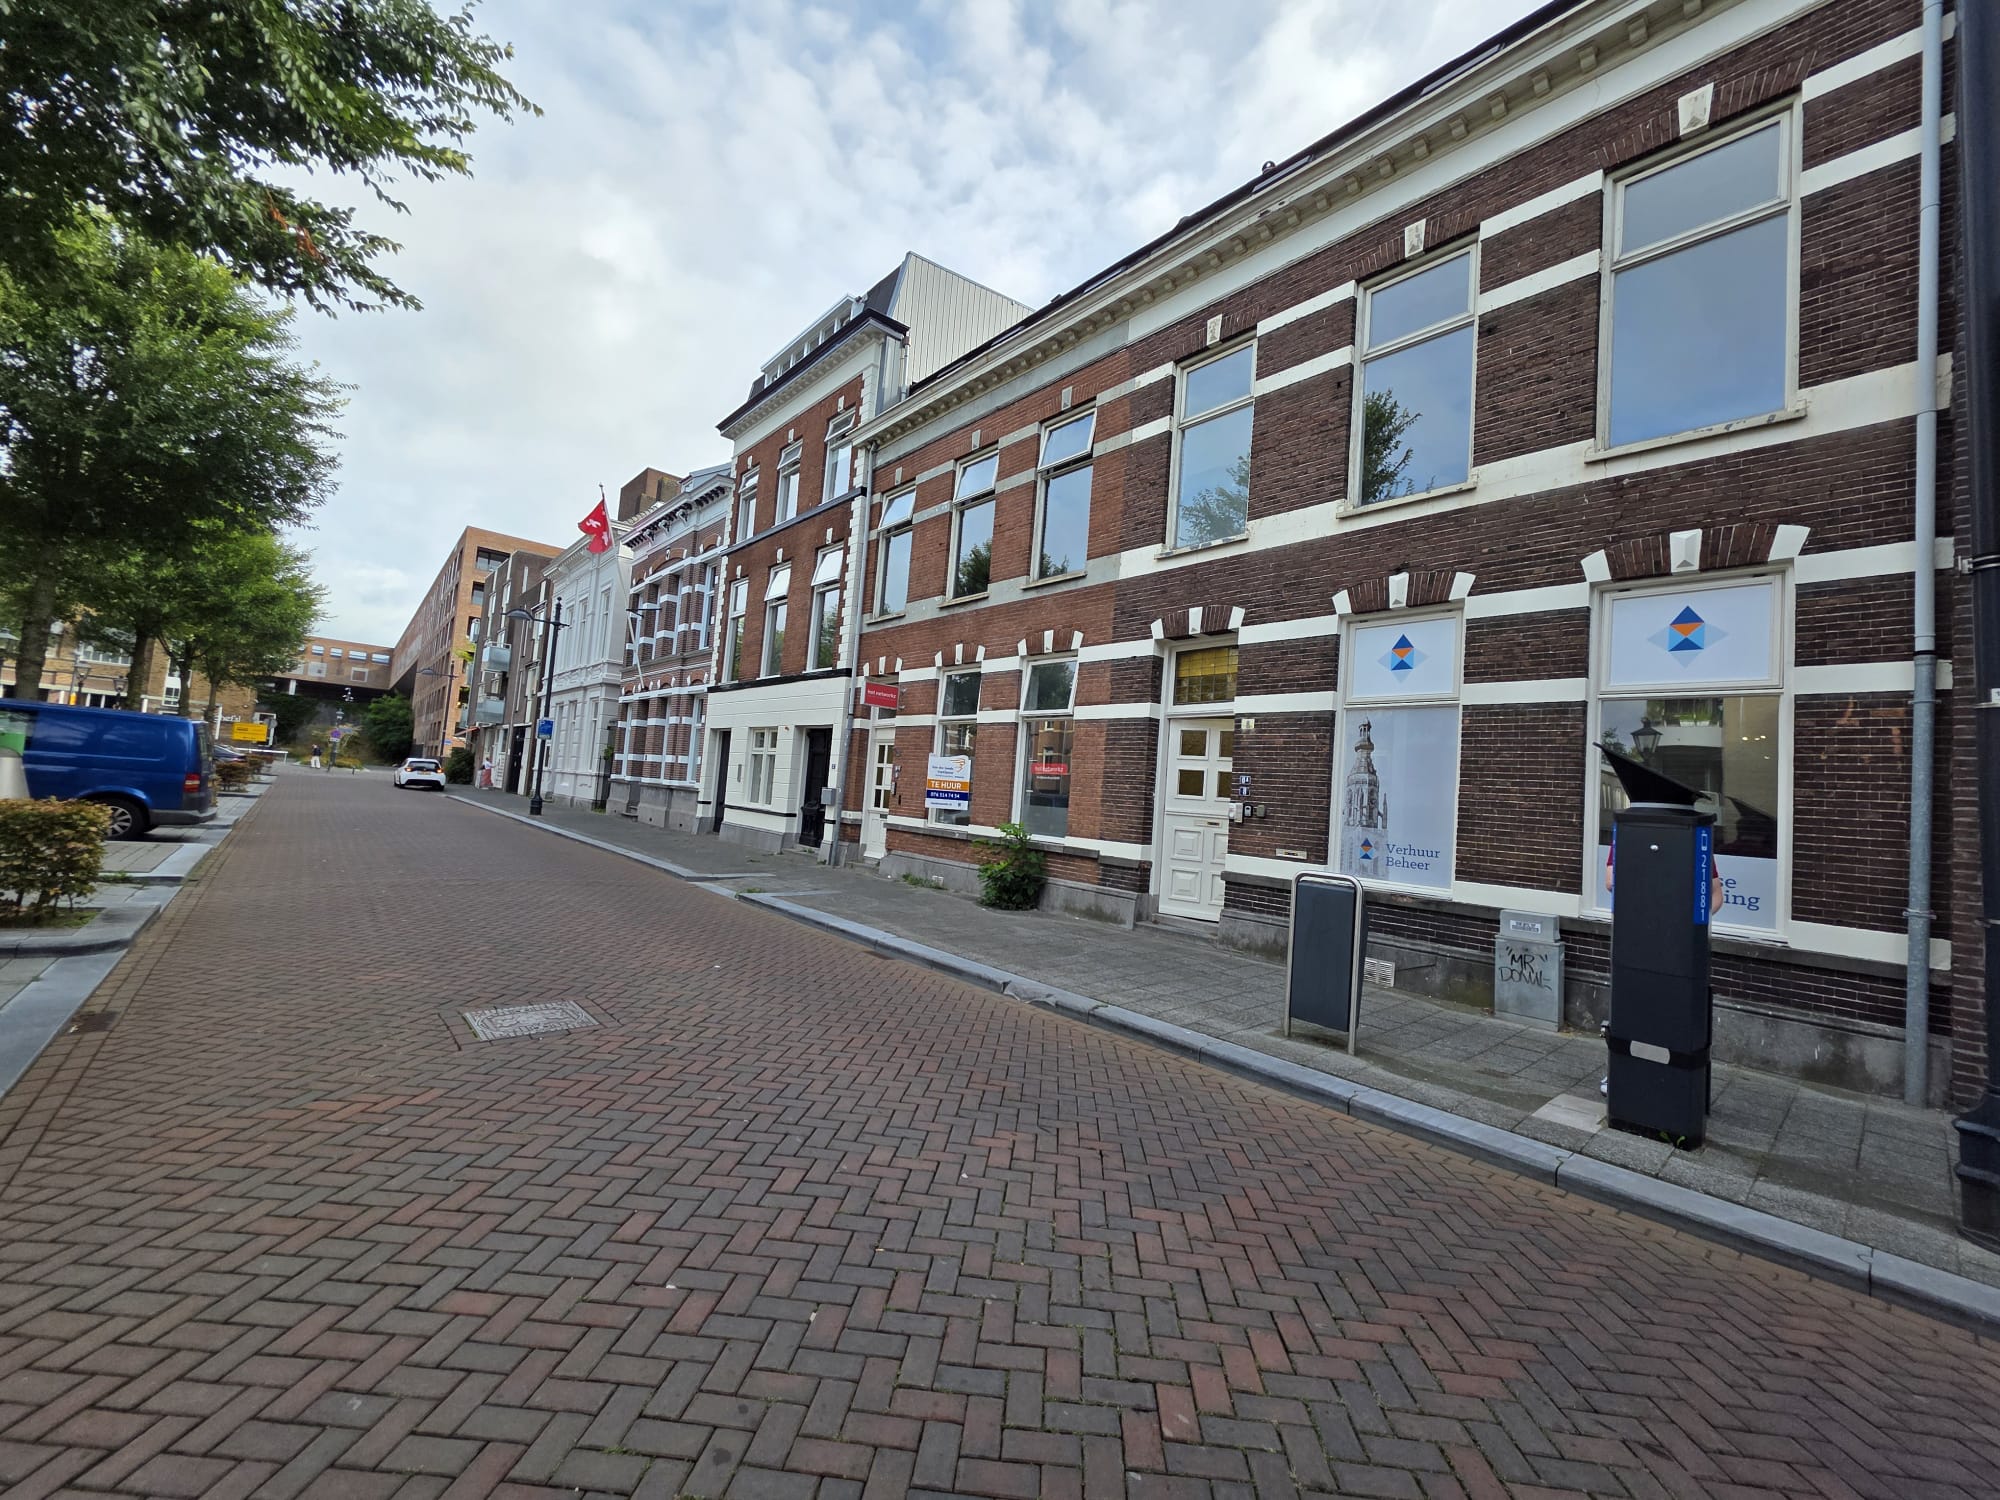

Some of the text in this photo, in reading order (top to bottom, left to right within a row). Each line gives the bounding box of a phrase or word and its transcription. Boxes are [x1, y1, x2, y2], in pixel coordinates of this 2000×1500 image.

[930, 780, 962, 790] TE HUUR
[1386, 843, 1440, 858] Verhuur
[1386, 856, 1430, 870] Beheer
[1723, 890, 1760, 911] ing
